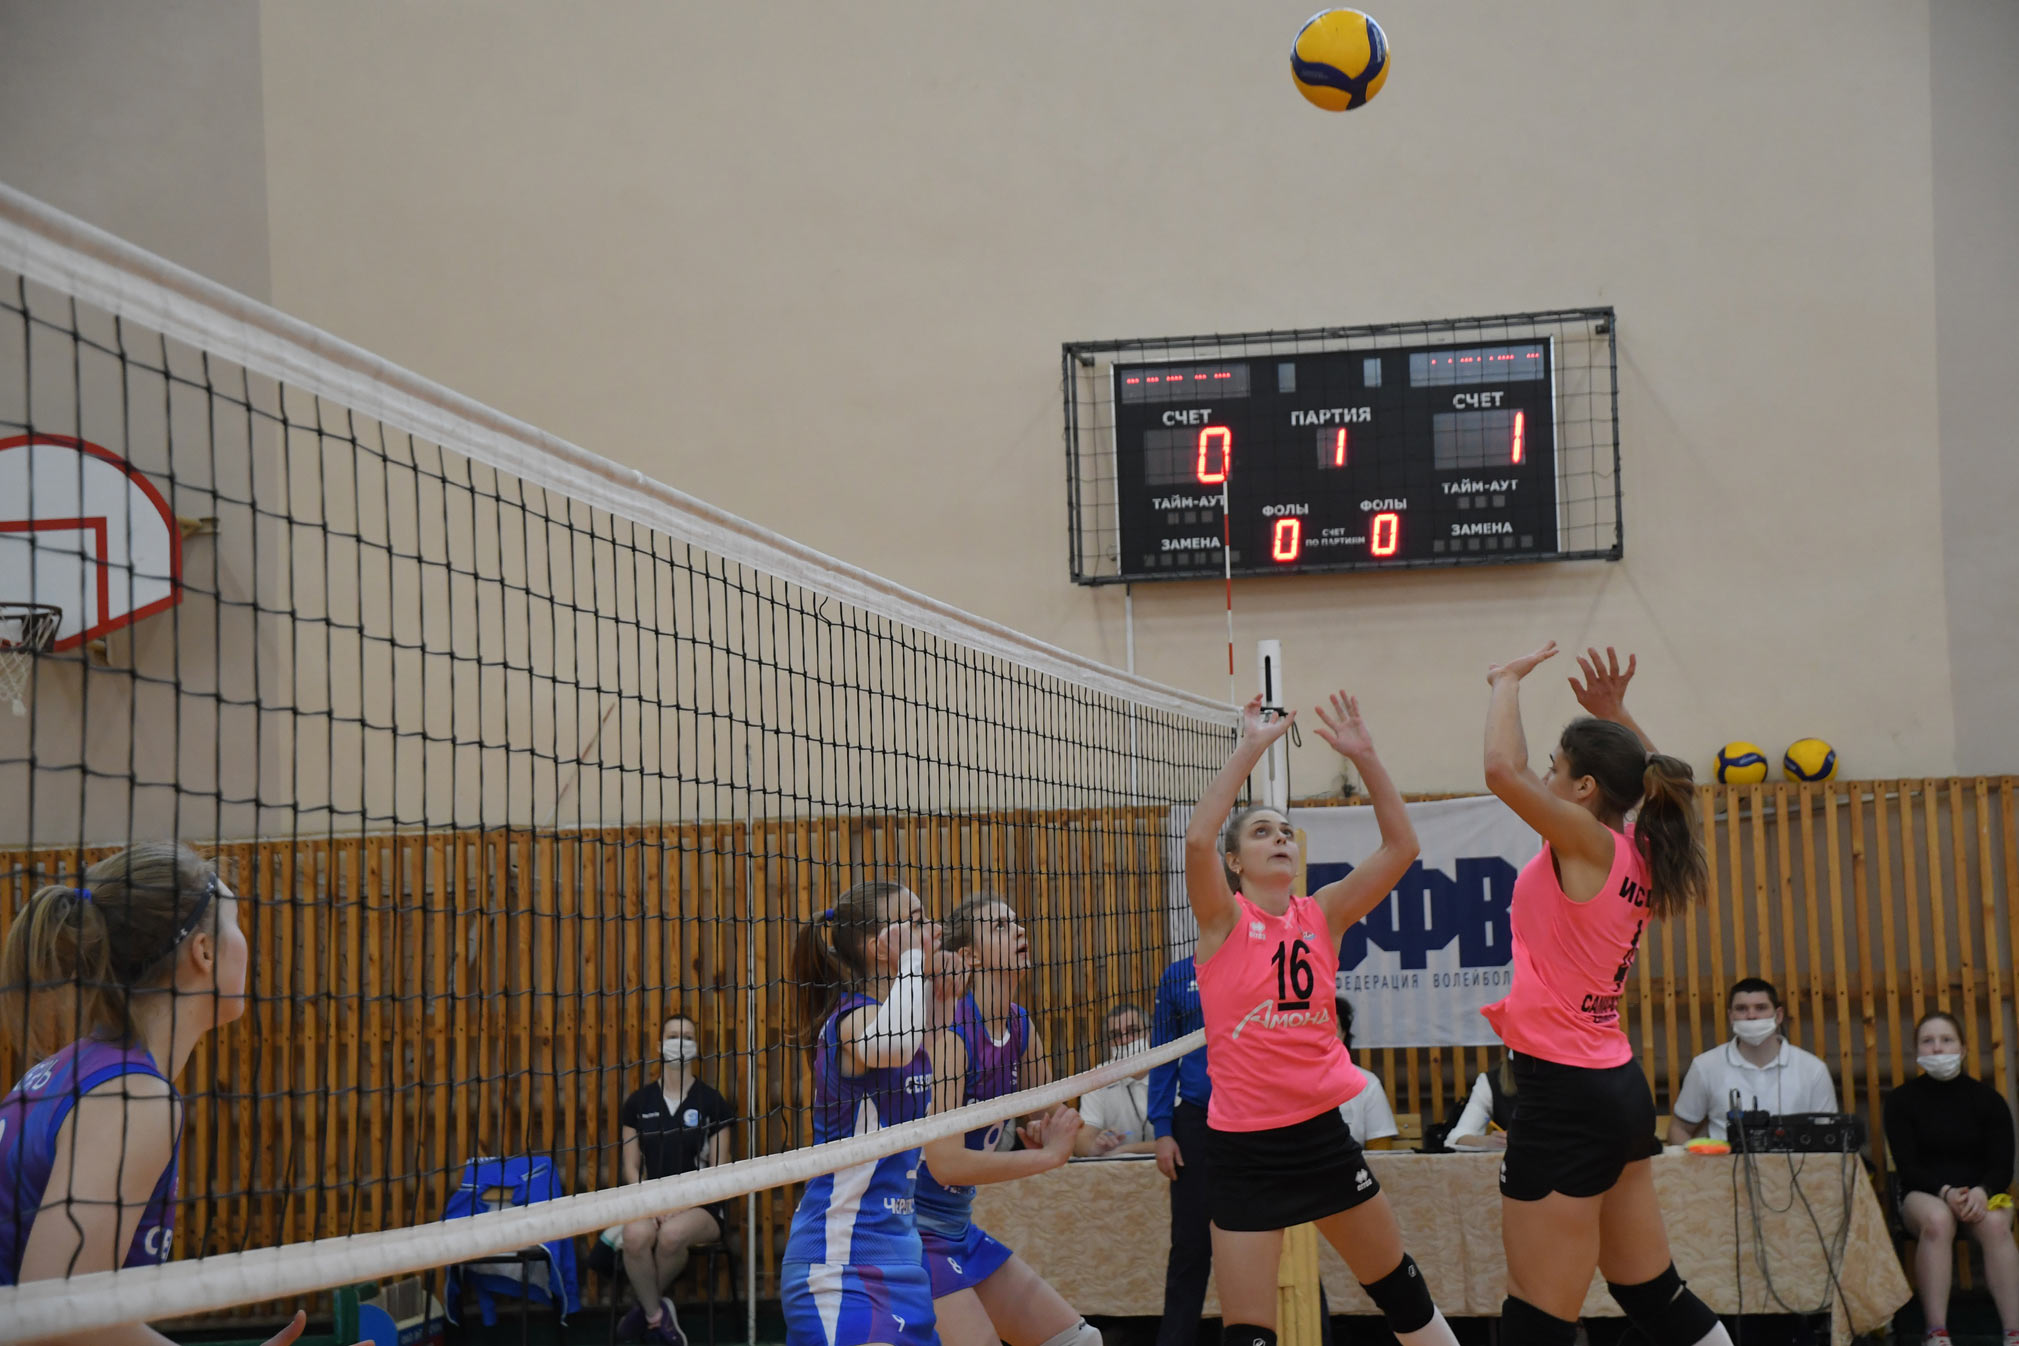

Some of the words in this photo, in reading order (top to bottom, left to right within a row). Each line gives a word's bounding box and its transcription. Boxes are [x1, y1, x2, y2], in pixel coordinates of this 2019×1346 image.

[1453, 391, 1504, 409] СЧЕТ
[1162, 409, 1212, 426] СЧЕТ
[1291, 406, 1372, 426] ПАРТИЯ
[1512, 411, 1524, 463] 1
[1197, 426, 1231, 483] 0
[1335, 427, 1346, 467] 1
[1442, 479, 1518, 494] ТАЙМ-АУТ
[1152, 494, 1226, 510] ТАЙМ-АУТ
[1262, 503, 1309, 516] ФОЛЫ
[1360, 498, 1407, 511] ФОЛЫ
[1371, 513, 1399, 556] 0
[1451, 522, 1513, 536] ЗАМЕНА
[1161, 536, 1220, 550] ЗАМЕНА
[1272, 518, 1300, 561] 0
[1305, 538, 1320, 547] ПО
[1271, 939, 1314, 1001] 16
[1336, 973, 1419, 992] ФЕДЕРАЦИЯ
[1433, 969, 1511, 989] ВОЛЕЙБОЛ
[947, 1256, 963, 1275] 8
